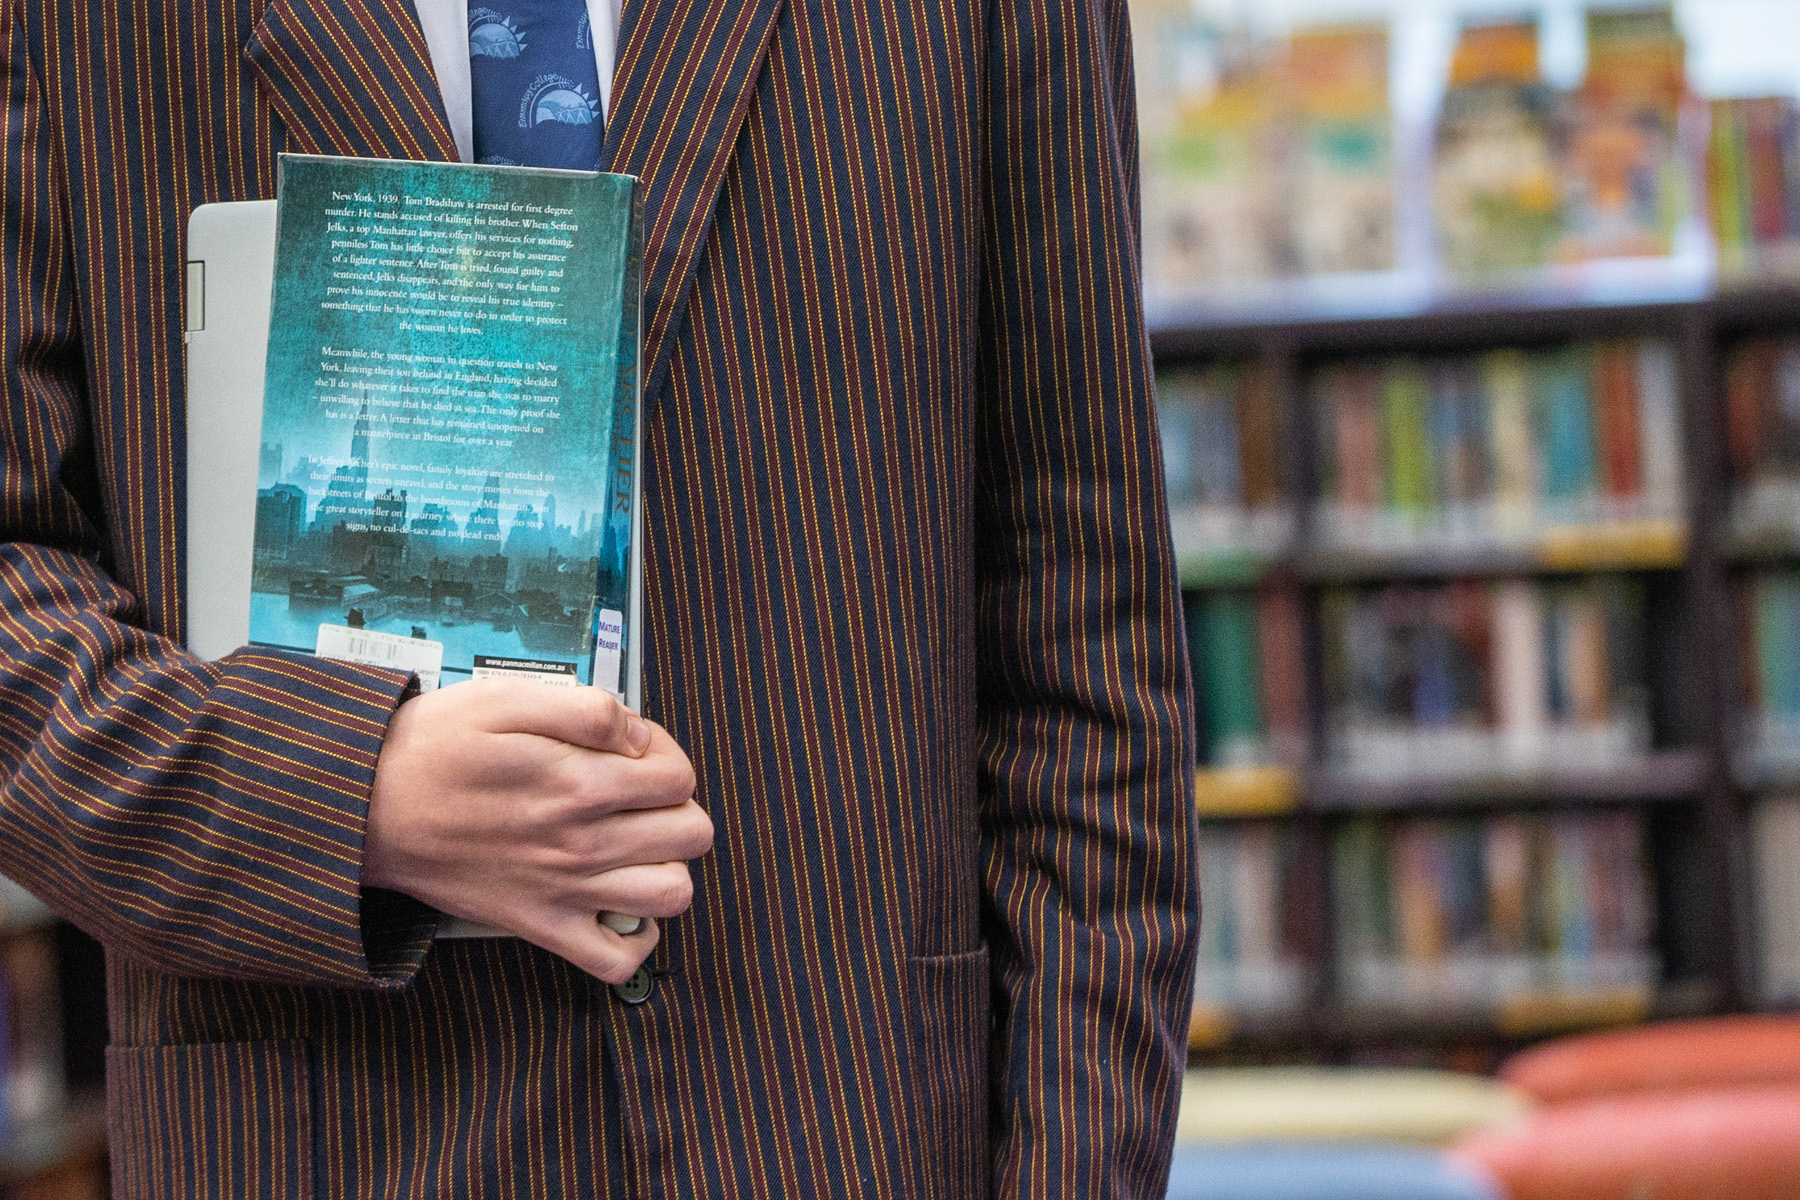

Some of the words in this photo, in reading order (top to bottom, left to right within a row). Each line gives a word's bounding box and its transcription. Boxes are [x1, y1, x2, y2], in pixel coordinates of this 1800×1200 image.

[332, 191, 351, 200] New
[402, 196, 422, 204] Tom
[425, 197, 464, 207] Bradshaw
[467, 200, 474, 208] is
[476, 200, 508, 210] arrested
[510, 202, 523, 211] for
[525, 203, 542, 212] first
[544, 205, 574, 216] degree
[358, 208, 371, 217] He
[373, 209, 398, 218] stands
[400, 211, 432, 221] accused
[433, 213, 443, 221] of
[445, 214, 471, 226] killing
[474, 216, 485, 224] his
[522, 219, 548, 228] When
[550, 221, 578, 230] Sefton
[356, 225, 370, 235] top
[372, 225, 417, 235] Manhattan
[448, 230, 472, 239] offers
[474, 231, 487, 240] his
[488, 233, 521, 242] services
[523, 235, 535, 243] for
[331, 238, 368, 250] penniless
[369, 240, 388, 249] Tom
[390, 242, 403, 250] has
[405, 242, 423, 251] little
[426, 244, 454, 253] choice
[456, 246, 470, 254] but
[483, 249, 510, 259] accept
[512, 249, 525, 258] his
[332, 253, 342, 261] of
[349, 254, 377, 266] lighter
[416, 259, 437, 268] After
[438, 260, 457, 269] Tom
[460, 262, 467, 270] is
[493, 264, 518, 273] found
[521, 266, 545, 277] guilty
[547, 267, 563, 276] and
[376, 272, 394, 283] Jelks
[442, 276, 457, 285] and
[459, 277, 473, 286] the
[475, 279, 493, 290] only
[496, 282, 513, 291] way
[516, 281, 529, 290] for
[530, 282, 548, 291] him
[326, 287, 349, 296] prove
[351, 286, 363, 294] his
[365, 287, 407, 297] innocence
[409, 289, 435, 299] would
[437, 291, 448, 299] be
[461, 293, 486, 302] reveal
[488, 294, 500, 303] his
[521, 297, 555, 309] identity
[321, 299, 364, 312] something
[365, 302, 381, 311] that
[383, 304, 393, 312] he
[396, 304, 409, 313] has
[475, 310, 486, 318] do
[488, 311, 497, 319] in
[500, 311, 523, 320] order
[536, 315, 567, 326] protect
[399, 320, 412, 329] the
[447, 323, 458, 332] he
[370, 350, 384, 358] the
[386, 353, 412, 363] young
[414, 355, 444, 363] woman
[458, 357, 494, 369] question
[496, 359, 523, 368] travels
[536, 361, 557, 370] New
[343, 364, 372, 376] leaving
[374, 366, 394, 375] their
[412, 369, 441, 378] behind
[493, 374, 521, 386] having
[523, 377, 557, 386] decided
[325, 505, 346, 515] great
[347, 505, 388, 518] storyteller
[383, 523, 428, 534] cul-de-sacs
[430, 527, 446, 535] and
[463, 529, 481, 538] dead
[599, 620, 620, 634] MATURE
[598, 638, 618, 650] READER
[485, 659, 566, 672] www.panmacmillan.com.au
